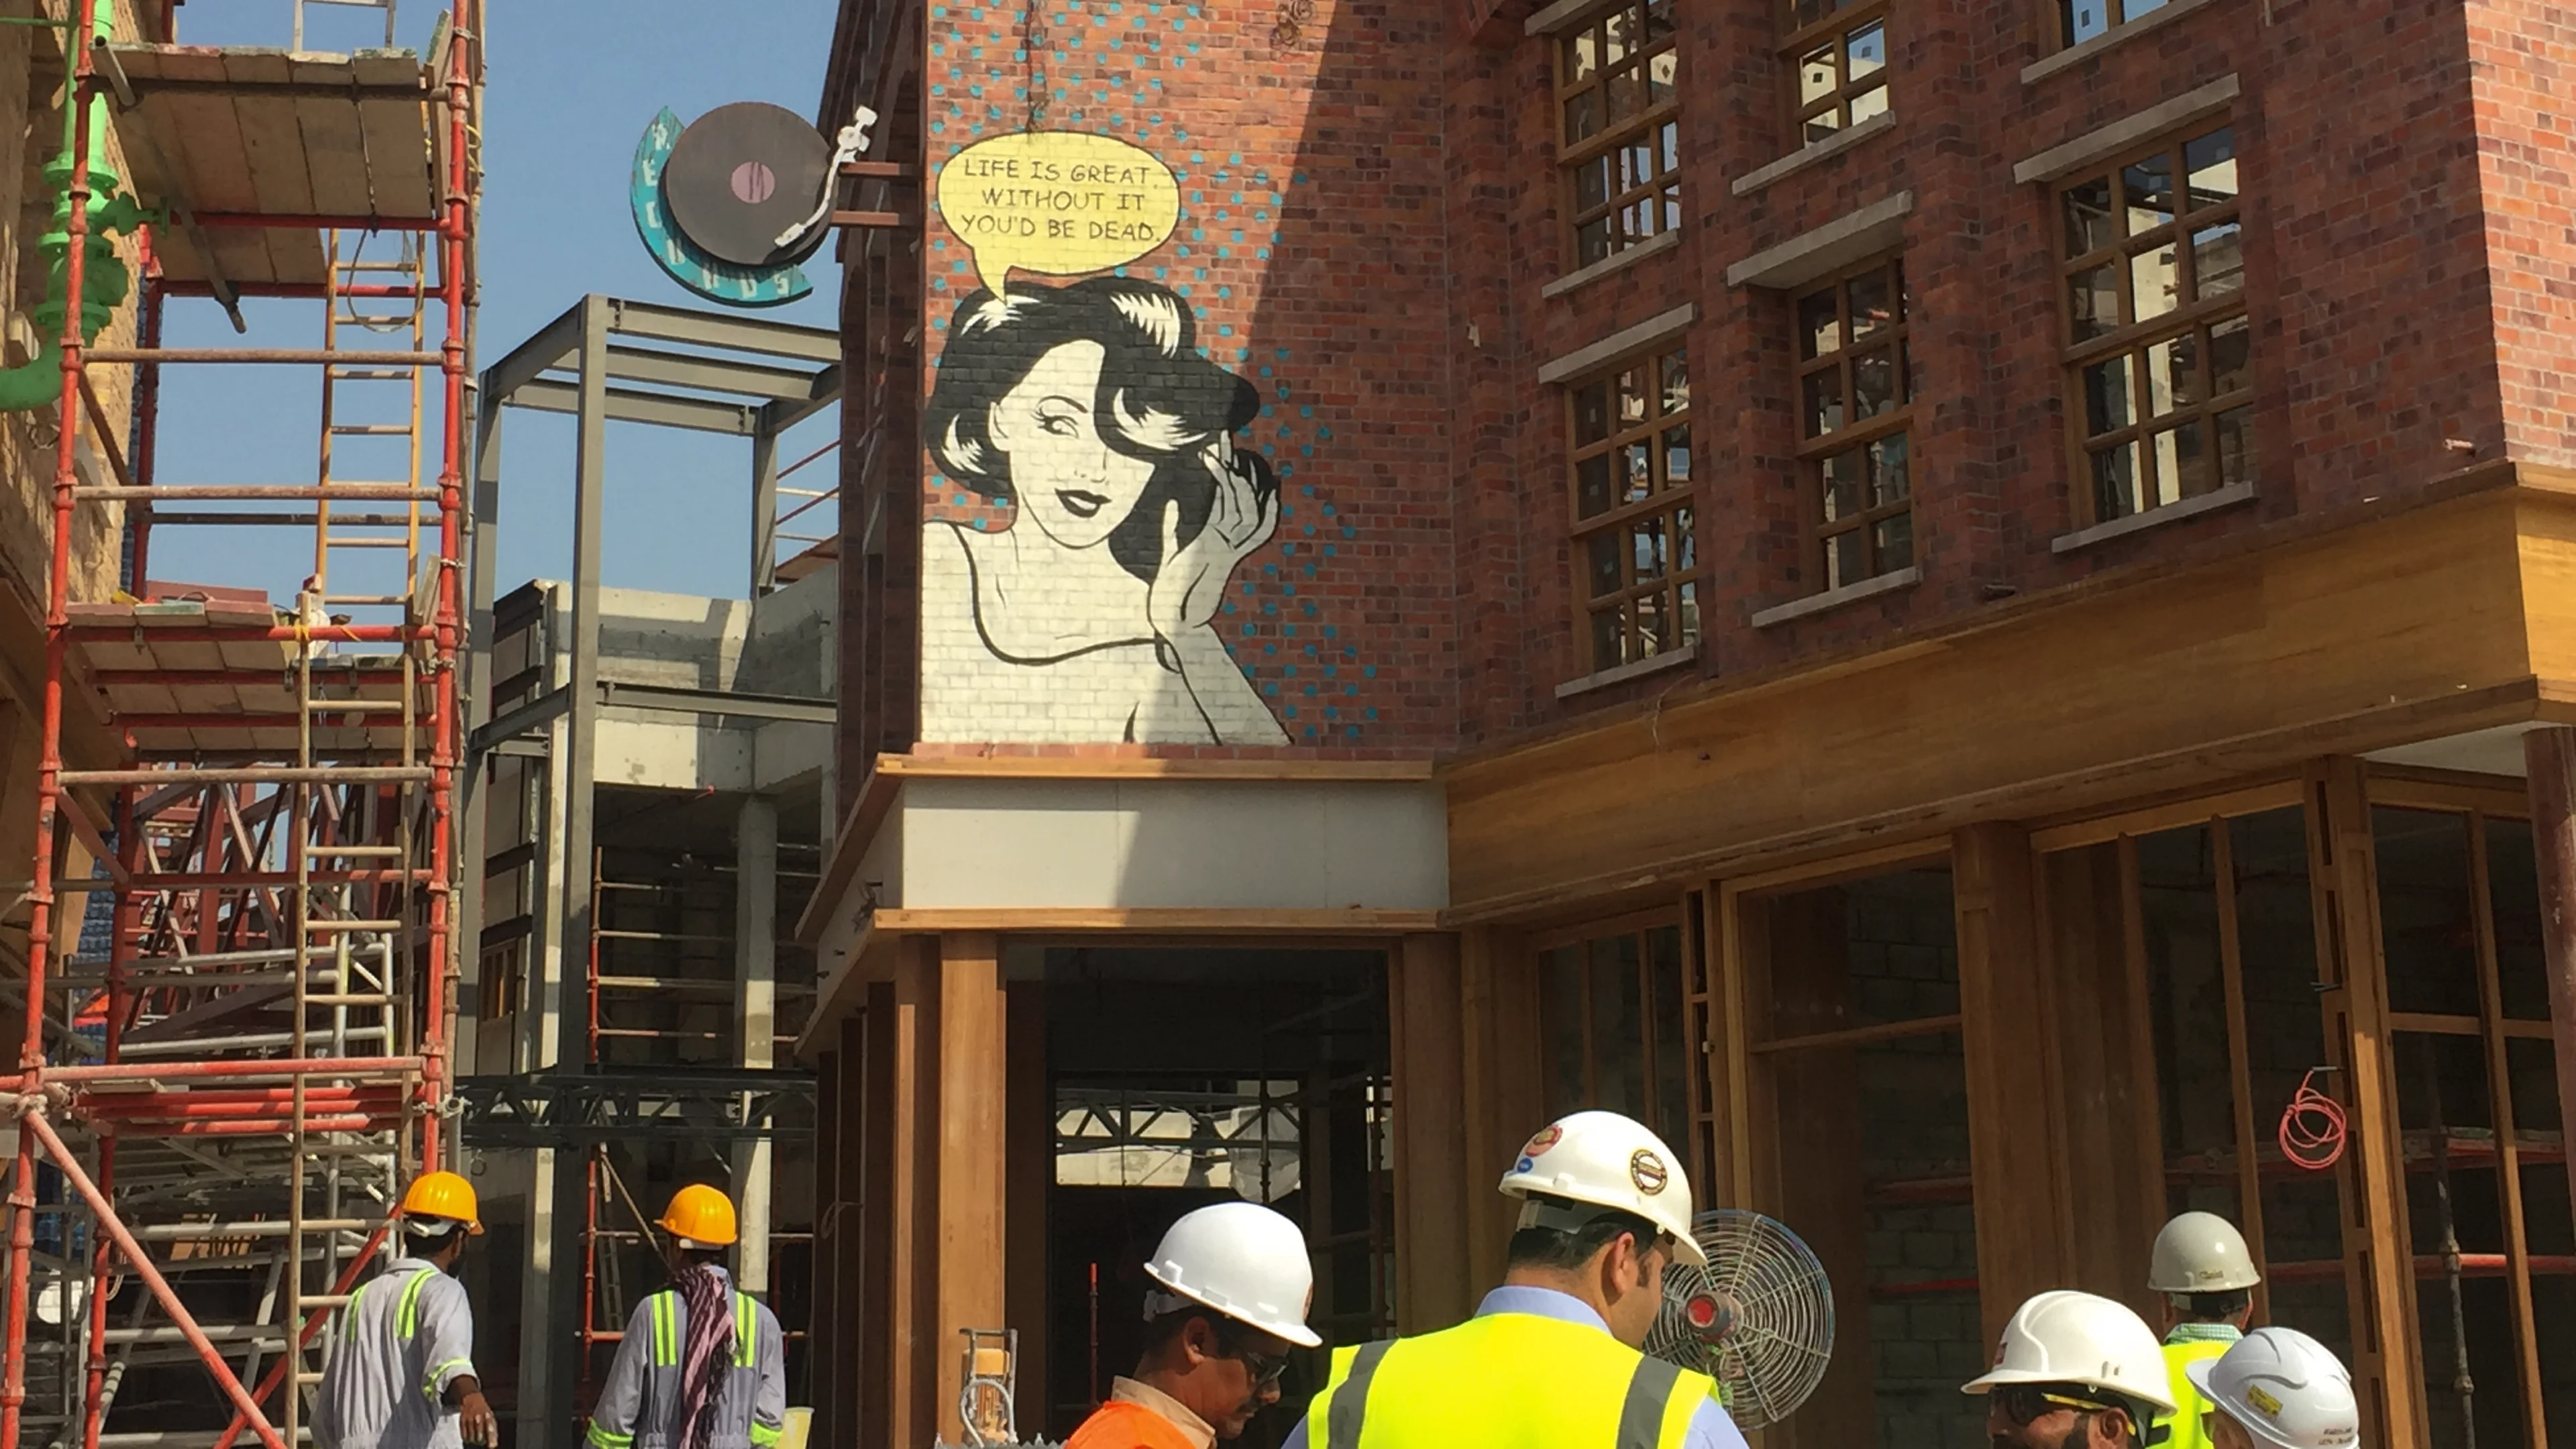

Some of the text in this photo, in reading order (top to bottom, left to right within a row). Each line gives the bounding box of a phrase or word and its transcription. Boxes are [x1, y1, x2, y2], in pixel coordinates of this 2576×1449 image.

[965, 158, 1019, 178] LIFE
[1030, 161, 1061, 181] IS
[982, 188, 1144, 211] WITHOUT IT
[961, 214, 1161, 242] YOU'D BE DEAD.
